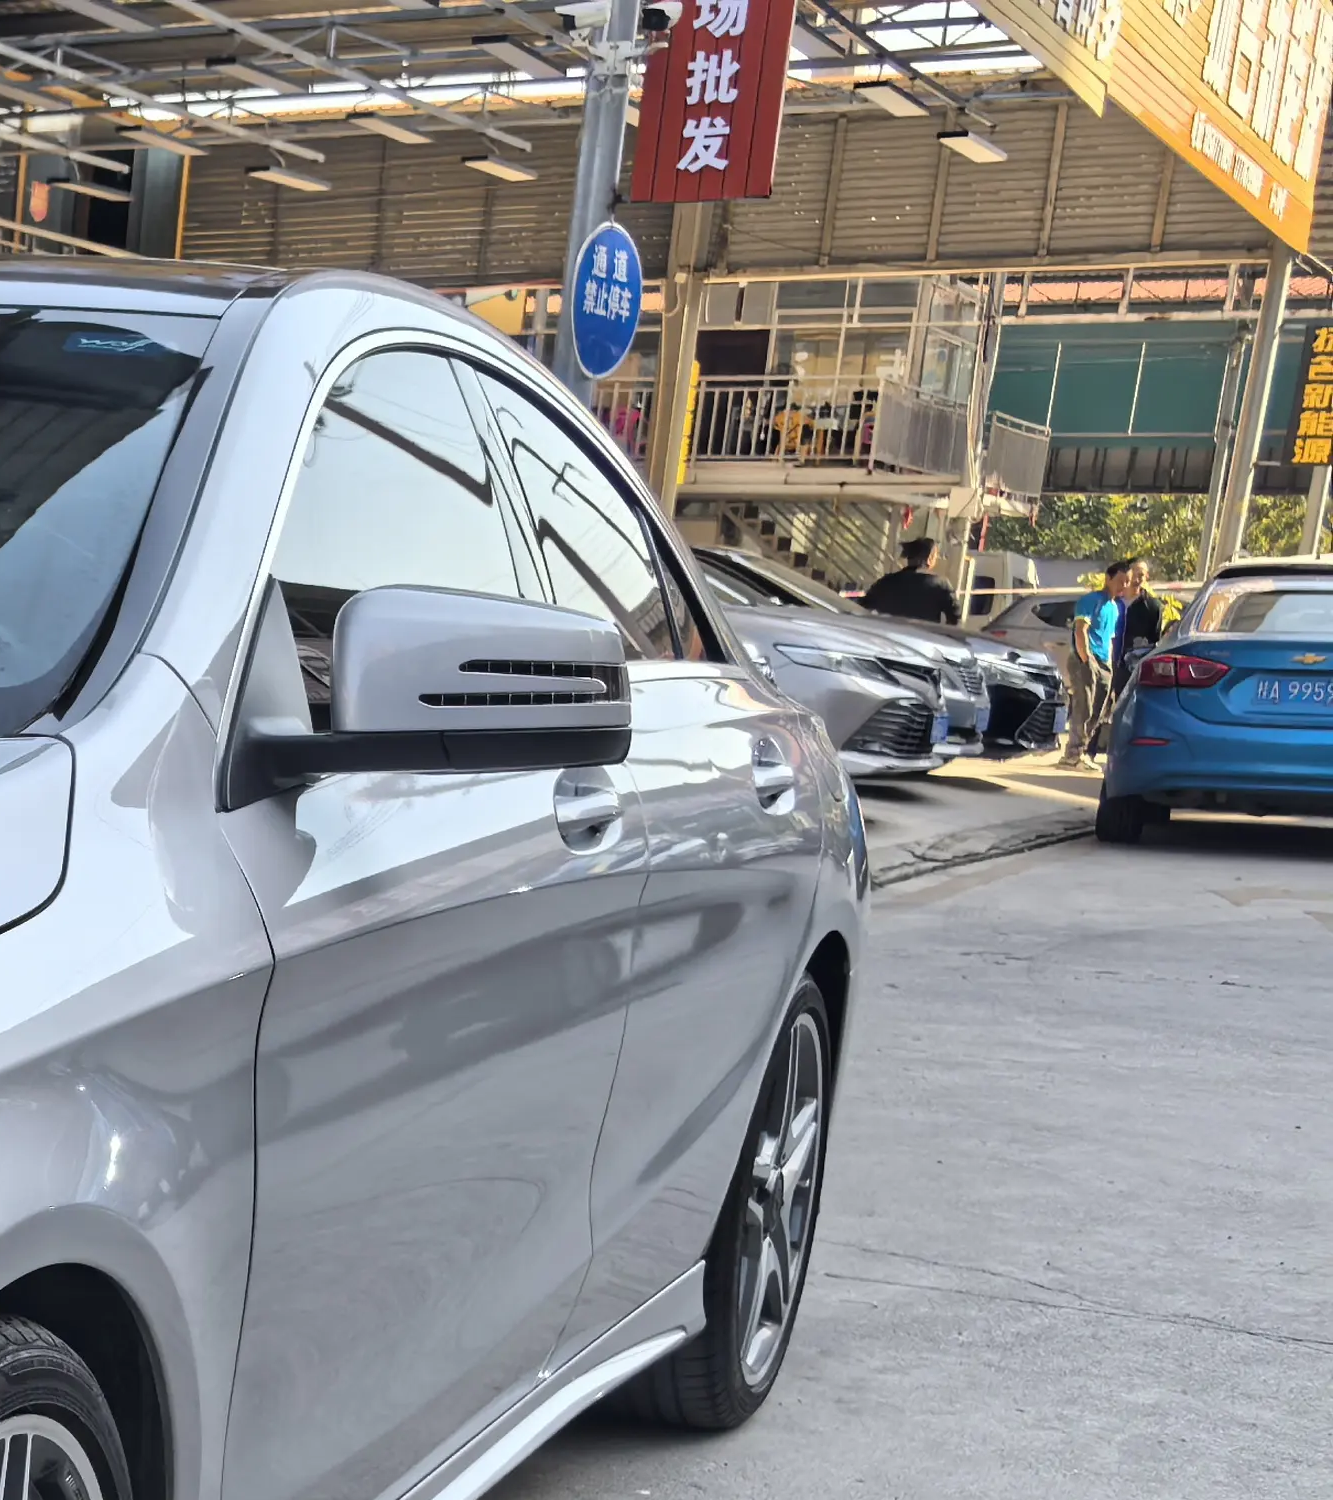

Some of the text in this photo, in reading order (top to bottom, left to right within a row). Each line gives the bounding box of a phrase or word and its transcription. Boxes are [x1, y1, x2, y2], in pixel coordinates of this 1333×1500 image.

[676, 0, 749, 174] 场批发
[592, 244, 628, 283] 通道
[583, 278, 633, 323] 禁止停车
